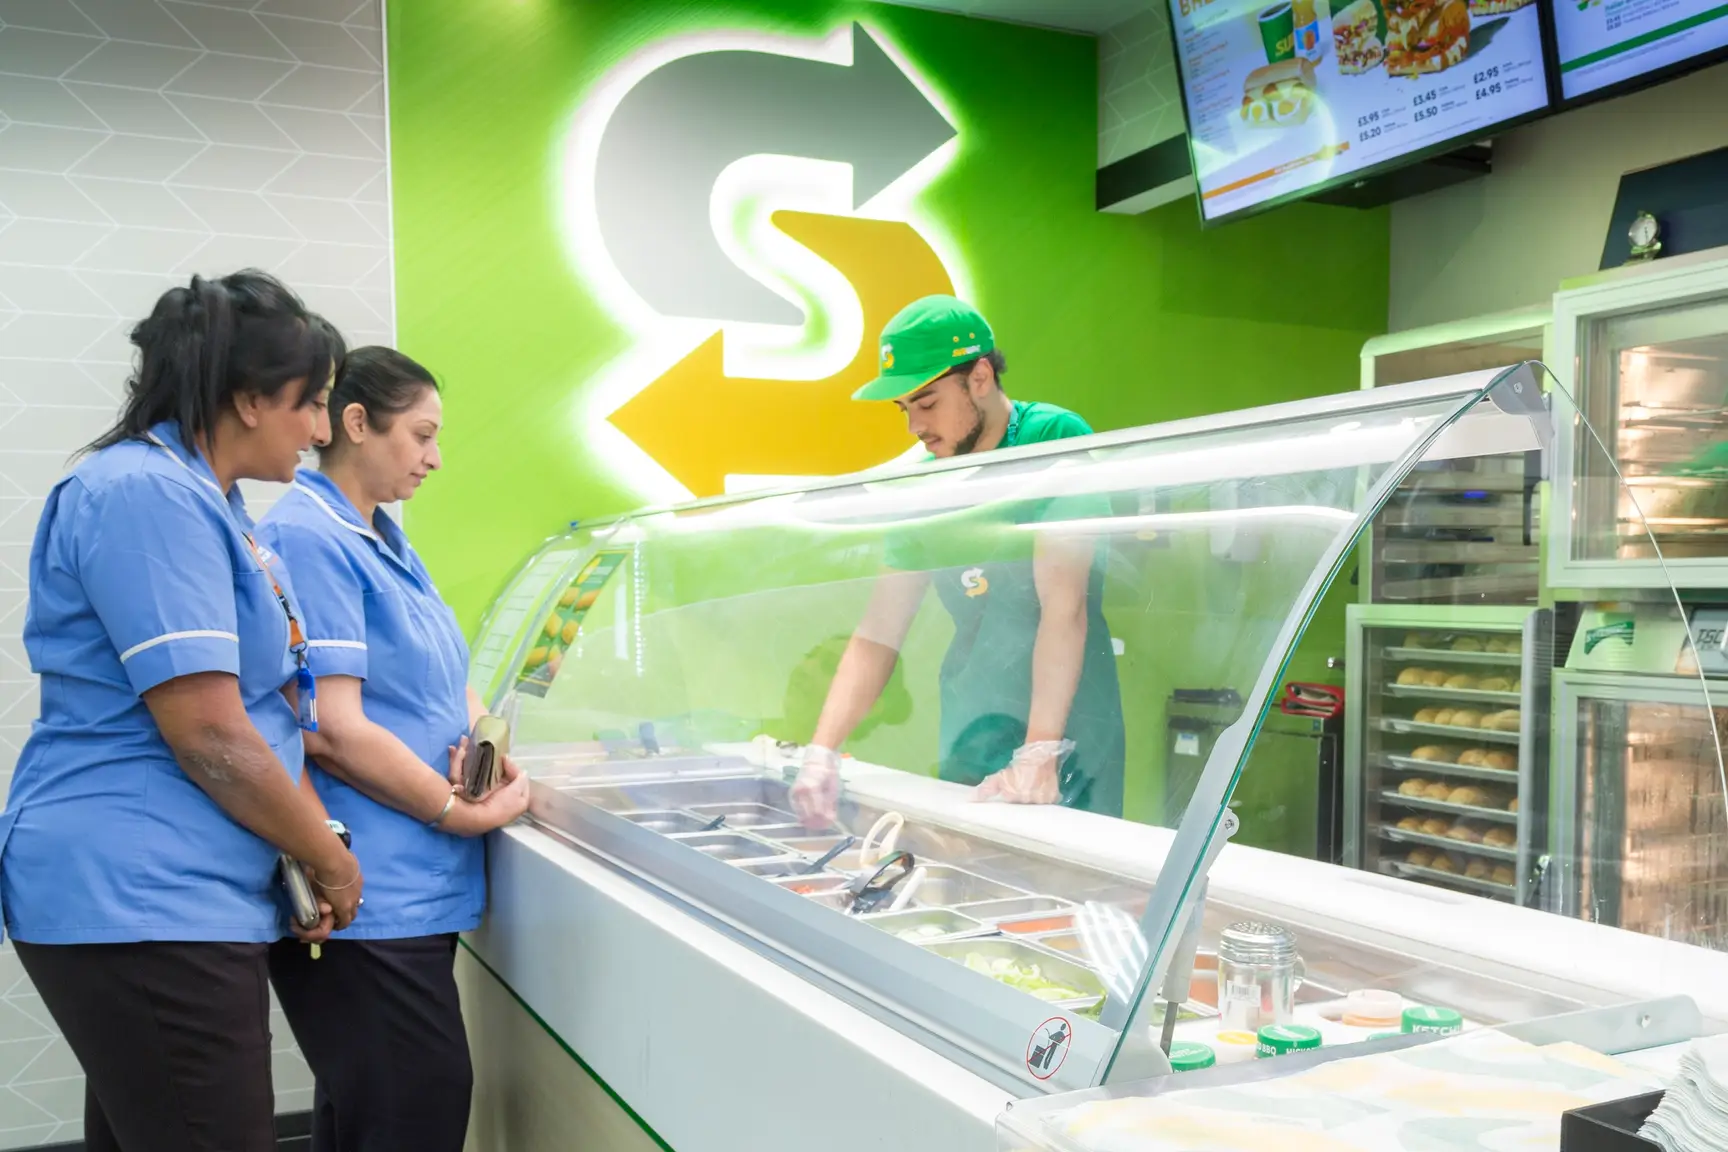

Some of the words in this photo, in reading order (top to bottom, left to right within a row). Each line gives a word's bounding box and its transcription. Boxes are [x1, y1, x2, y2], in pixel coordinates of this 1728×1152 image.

[1474, 66, 1500, 83] £2.95
[1413, 90, 1437, 107] £3.45
[1476, 82, 1502, 99] £4.95
[1357, 111, 1380, 127] £3.95
[1414, 106, 1438, 123] £5.50
[1359, 126, 1382, 142] £5.20
